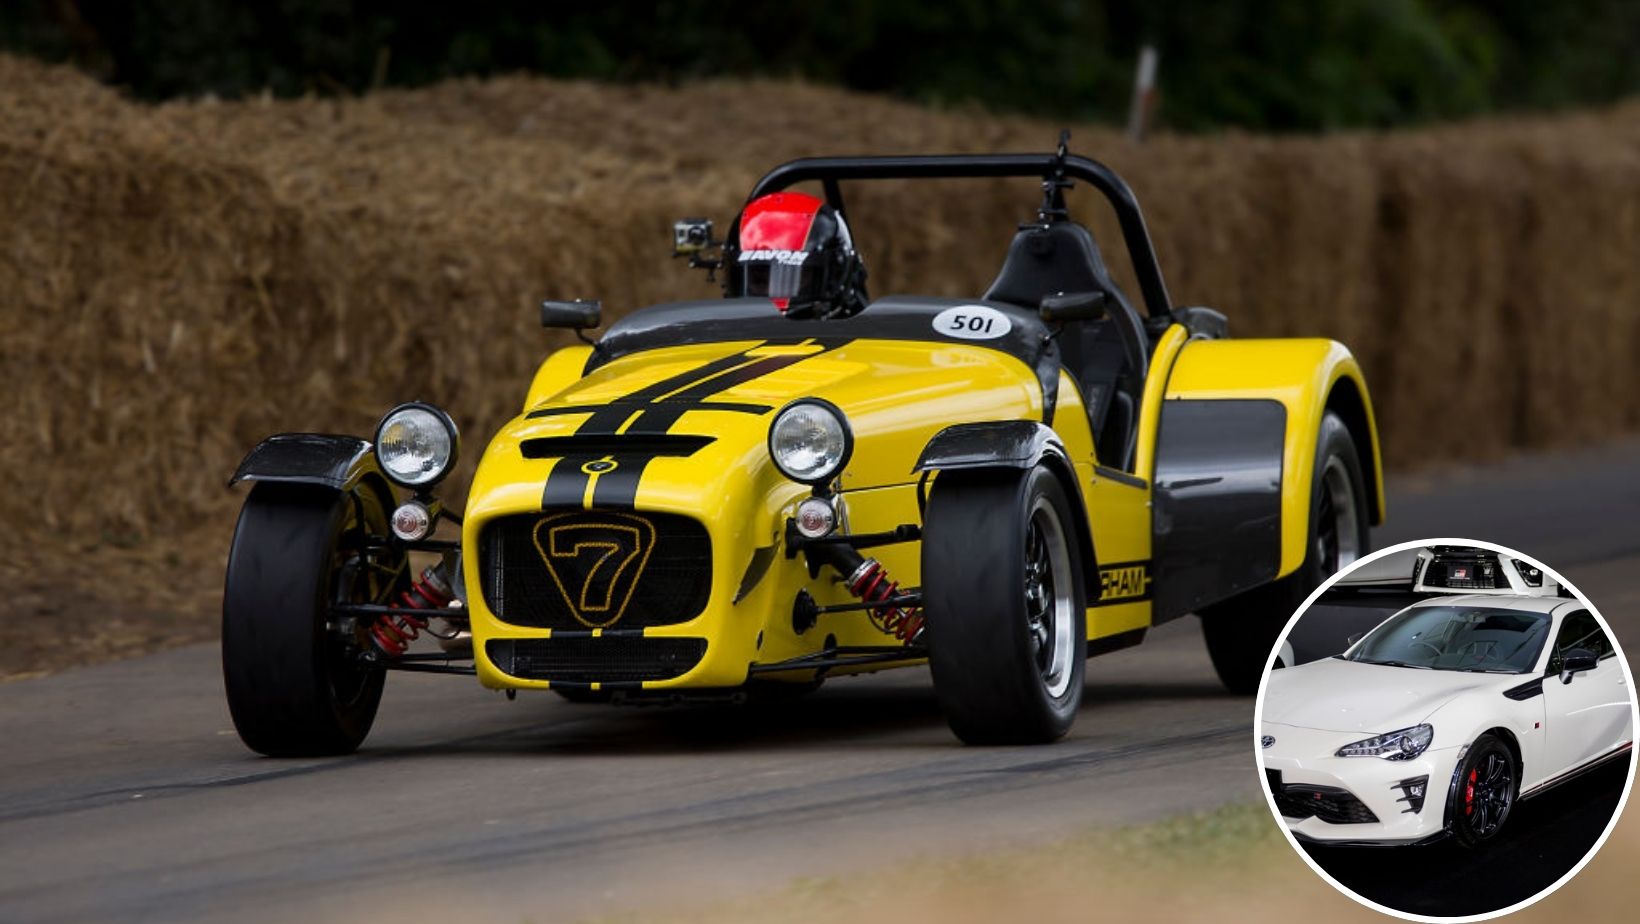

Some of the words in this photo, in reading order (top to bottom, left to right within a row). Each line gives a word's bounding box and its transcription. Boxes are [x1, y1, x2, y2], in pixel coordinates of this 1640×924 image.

[751, 250, 809, 262] AVON
[950, 315, 994, 333] 501
[549, 523, 641, 612] 7
